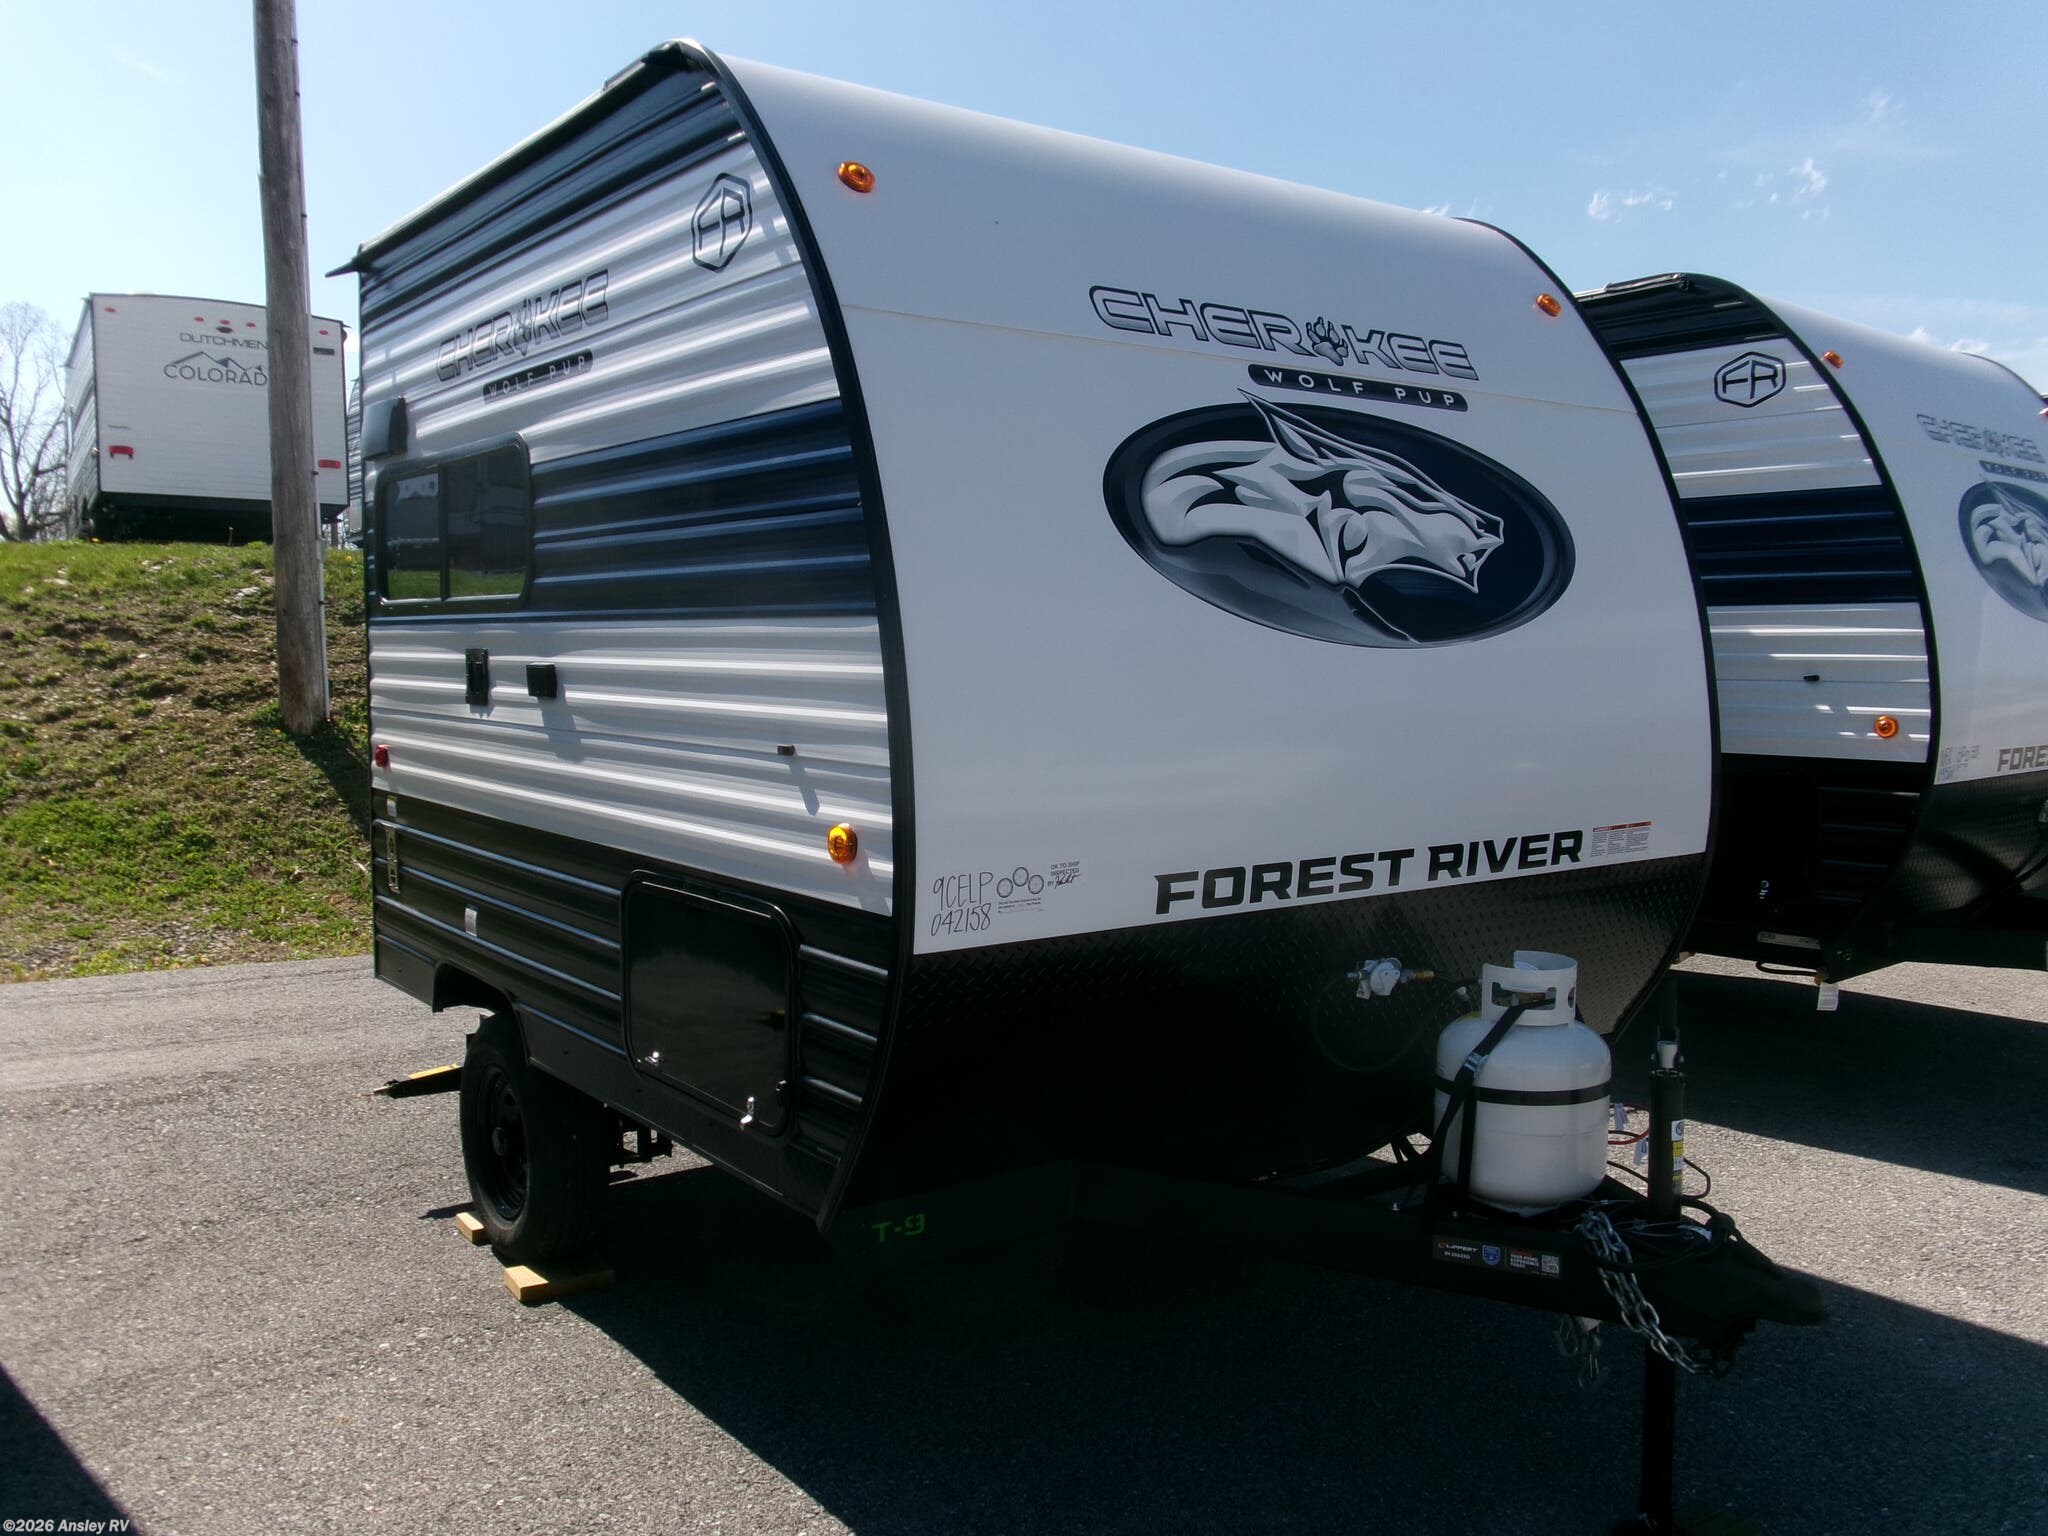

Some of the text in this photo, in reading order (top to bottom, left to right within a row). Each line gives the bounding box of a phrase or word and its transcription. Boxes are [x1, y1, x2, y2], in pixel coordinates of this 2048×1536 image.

[163, 363, 268, 386] COLORAD
[489, 354, 586, 396] WOLF PUP
[1263, 369, 1456, 406] WOLF PUP
[1997, 744, 2048, 772] FORE
[1155, 848, 1415, 915] FOREST
[1427, 829, 1584, 882] RIVER
[931, 902, 992, 936] 042158
